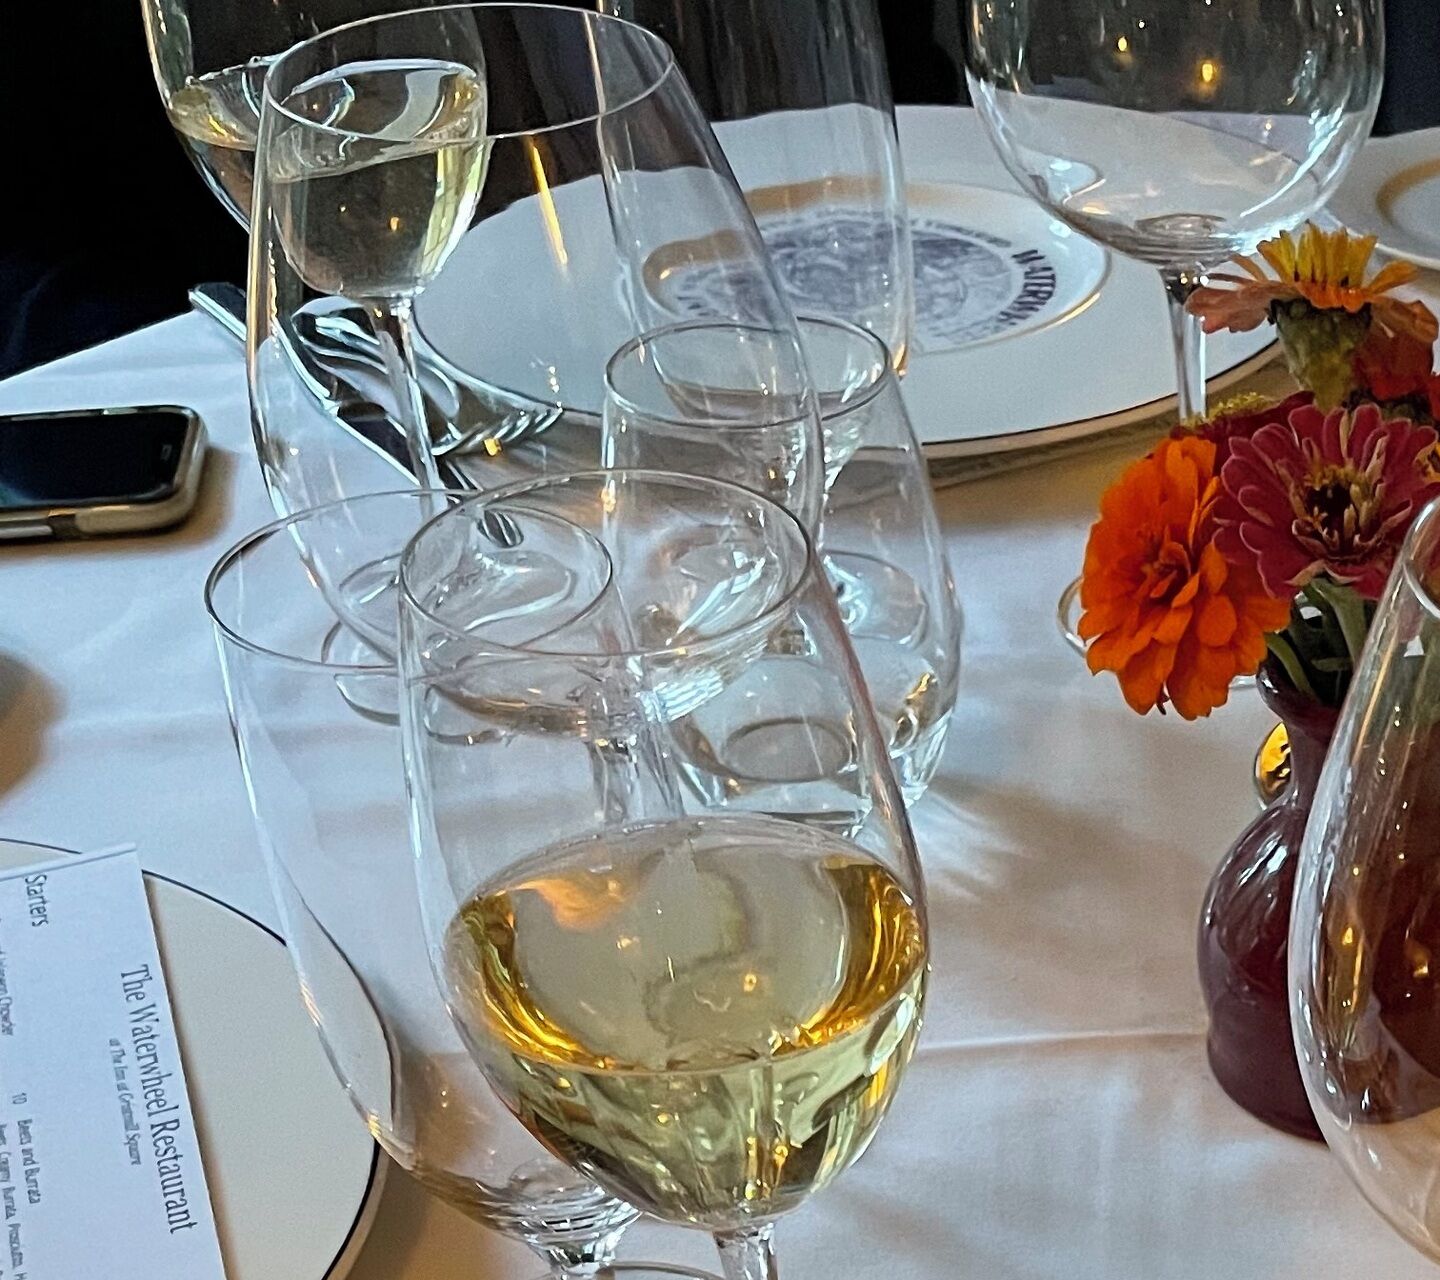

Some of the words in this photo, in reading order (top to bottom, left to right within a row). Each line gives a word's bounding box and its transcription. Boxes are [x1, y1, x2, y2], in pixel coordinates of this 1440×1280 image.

[25, 874, 49, 927] Starters
[120, 964, 153, 1002] The
[129, 1003, 180, 1118] Waterwheel
[12, 1093, 28, 1105] 10
[110, 1048, 127, 1064] The
[124, 1133, 142, 1165] Square
[22, 1149, 39, 1166] and
[151, 1119, 198, 1234] Restaurant
[25, 1167, 41, 1204] Burrata
